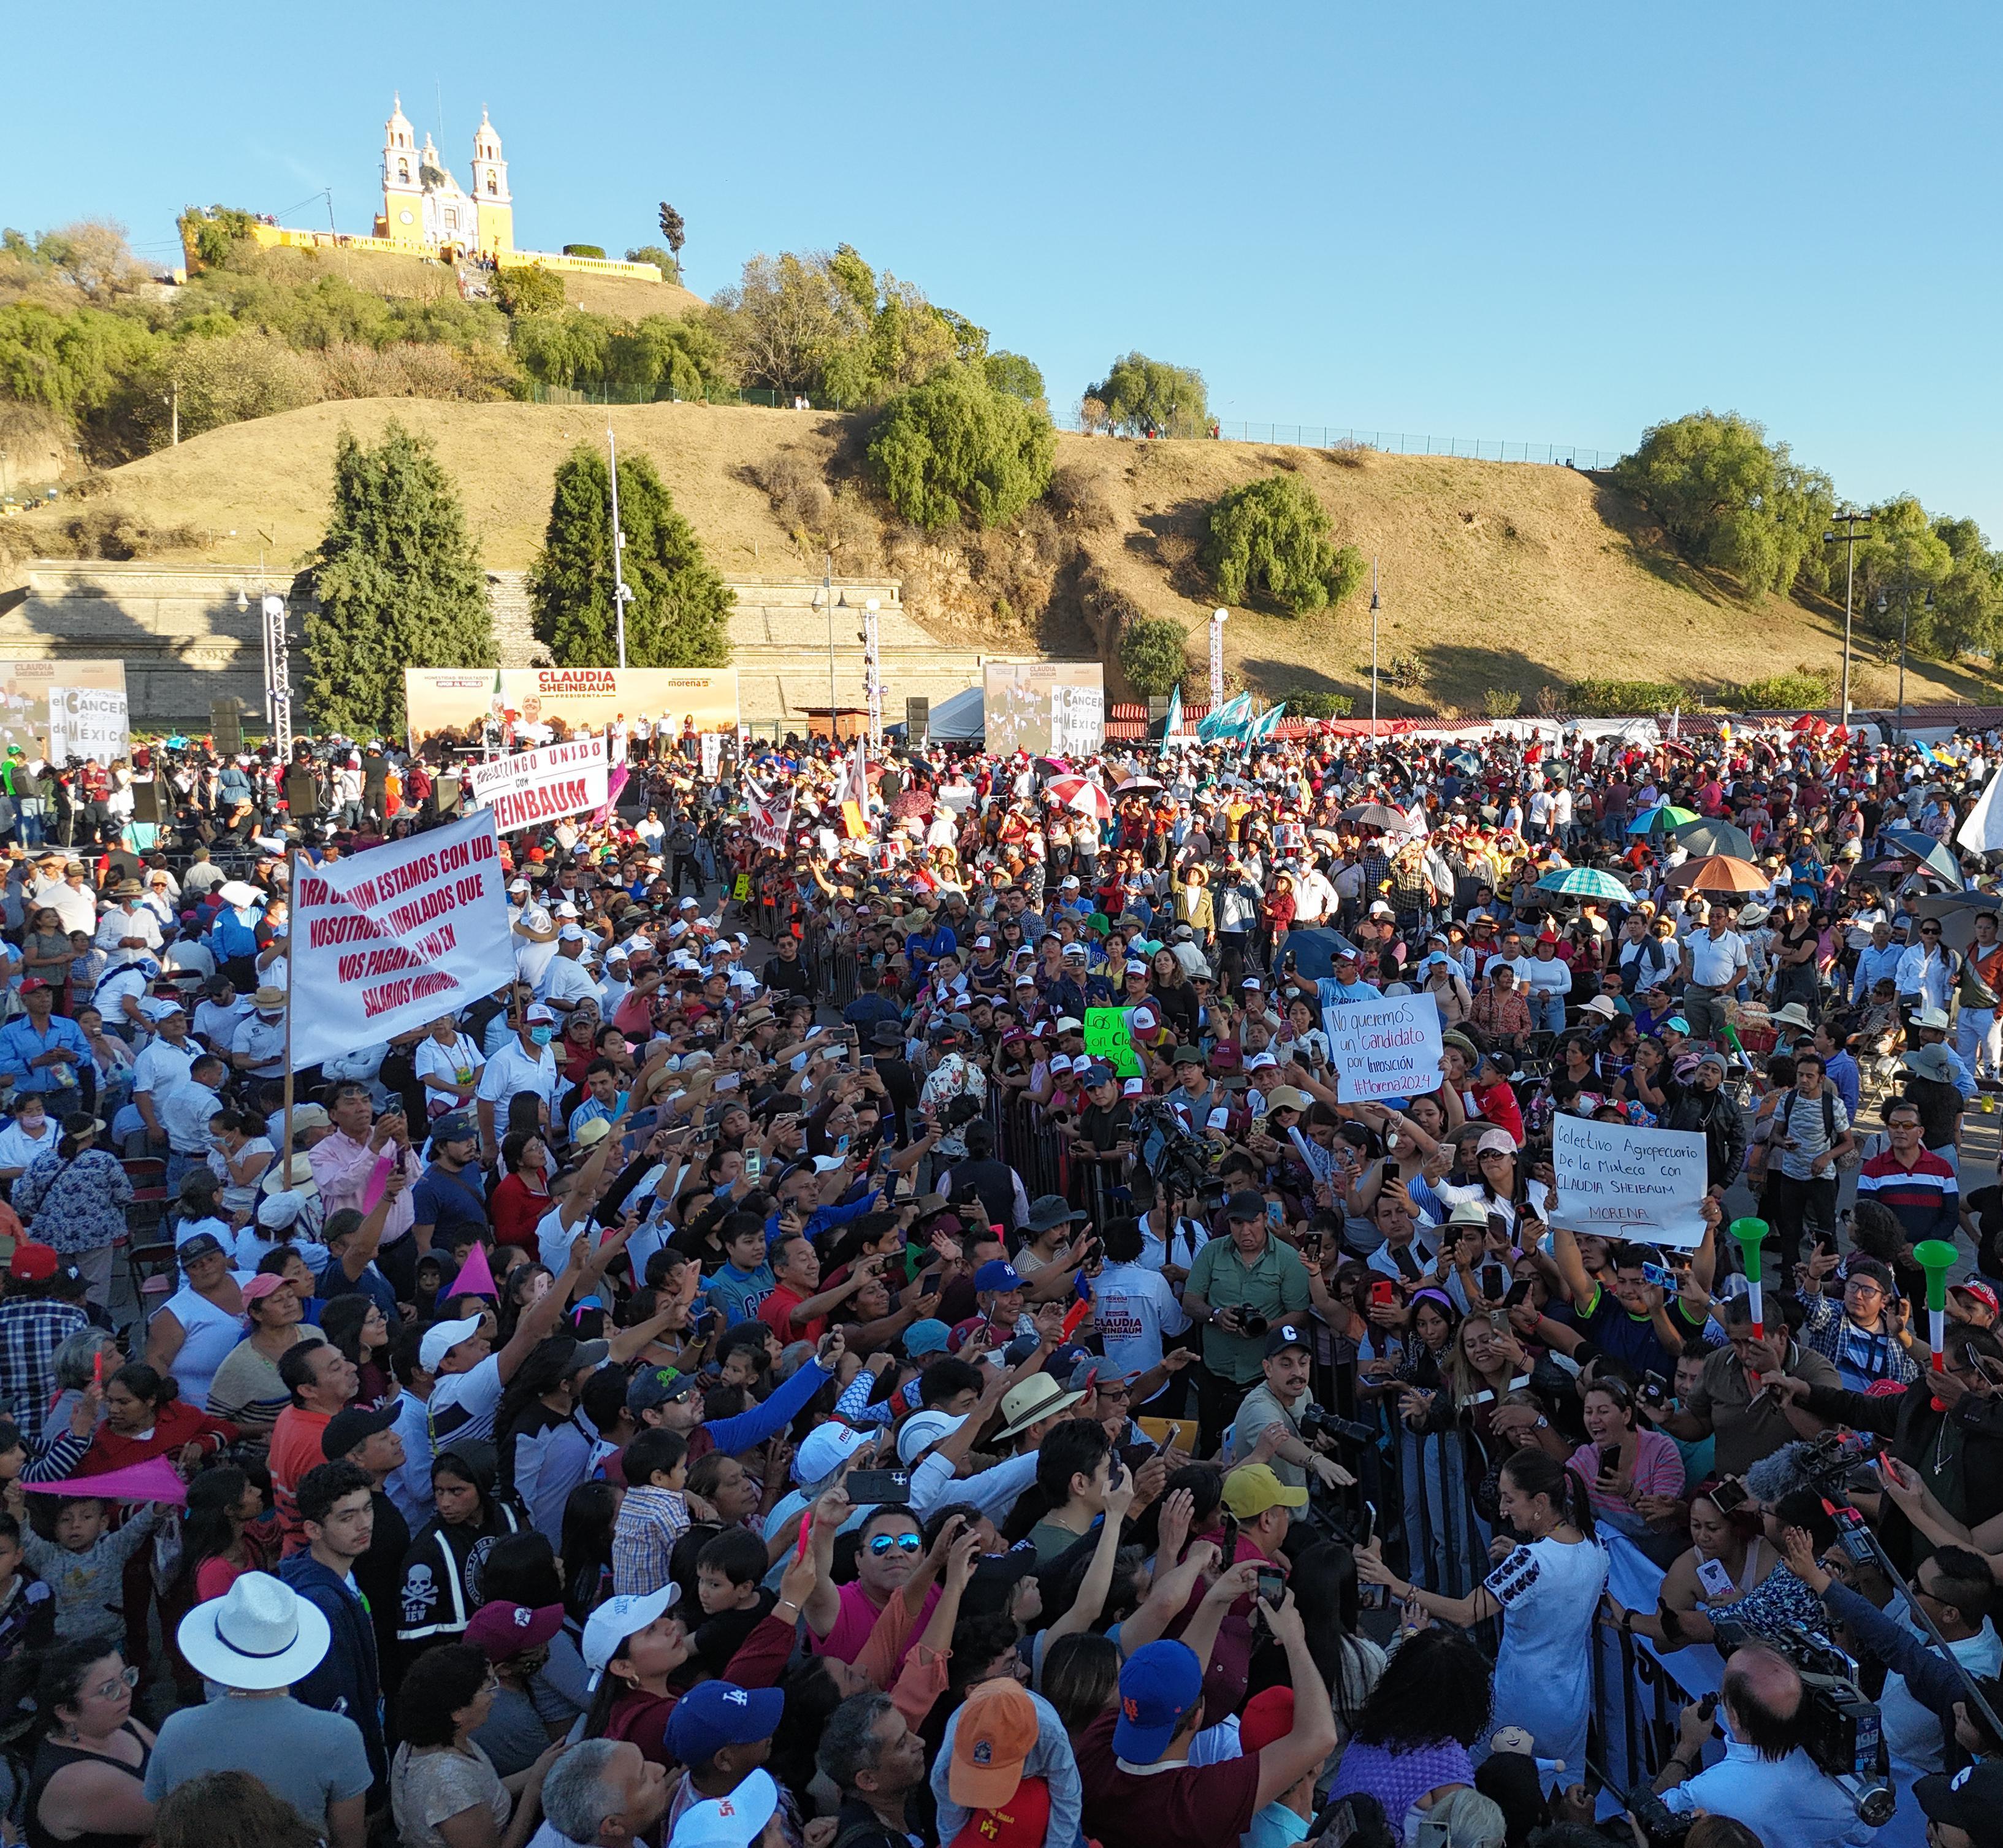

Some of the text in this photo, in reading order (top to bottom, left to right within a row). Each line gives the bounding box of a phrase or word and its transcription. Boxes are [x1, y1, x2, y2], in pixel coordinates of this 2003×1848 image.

[539, 671, 615, 682] CLAUDIA
[539, 683, 616, 692] SHEINBAUM
[53, 696, 64, 706] el
[1054, 692, 1062, 701] el
[1054, 715, 1063, 724] de
[53, 724, 67, 735] de
[549, 742, 601, 765] UNIDO
[516, 777, 529, 788] CON
[484, 778, 589, 829] HEINBAUM
[300, 878, 329, 908] DRA
[376, 853, 438, 902] ESTAMOS
[440, 841, 470, 874] CON
[471, 834, 497, 862] UD.
[456, 873, 484, 906] QUE
[338, 952, 366, 983] NOS
[365, 945, 409, 977] PAGAN
[423, 931, 443, 961] NO
[438, 922, 457, 952] EN
[362, 977, 413, 1018] SALARIOS
[1332, 1010, 1347, 1032] No
[1340, 1039, 1357, 1053] un
[1347, 1056, 1365, 1073] por
[1354, 1074, 1430, 1096] #Morena2024
[1559, 1125, 1698, 1162] Colectivo Agropecuario
[1559, 1153, 1573, 1168] De
[1579, 1155, 1590, 1171] la
[1557, 1173, 1674, 1195] CLAUDIA SHEIBAUM
[1589, 1206, 1649, 1220] MORENA
[1094, 1318, 1142, 1327] CLAUDIA
[1282, 1325, 1297, 1340] C
[980, 1820, 998, 1839] PT
